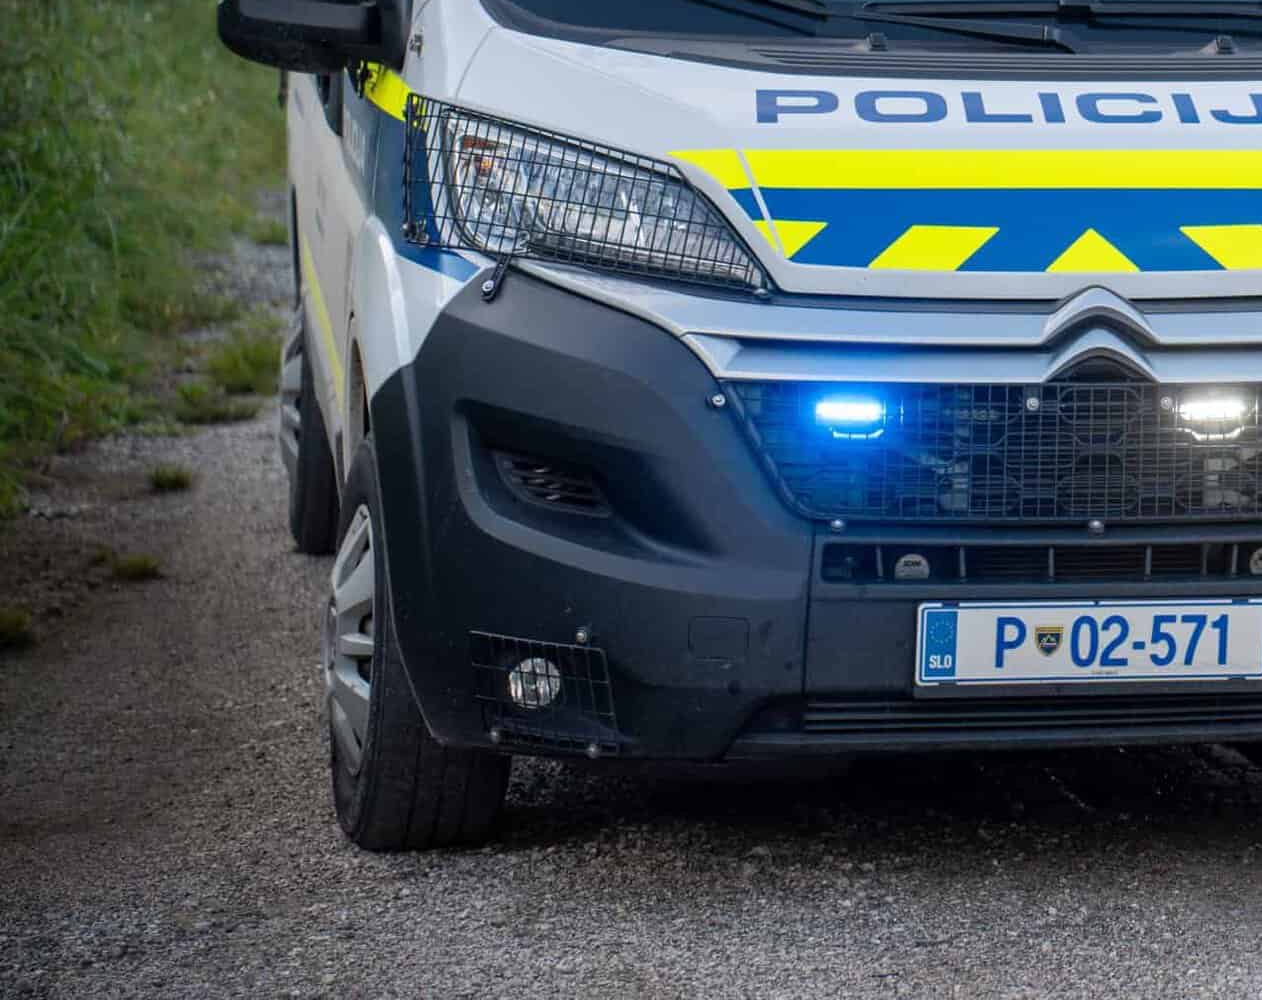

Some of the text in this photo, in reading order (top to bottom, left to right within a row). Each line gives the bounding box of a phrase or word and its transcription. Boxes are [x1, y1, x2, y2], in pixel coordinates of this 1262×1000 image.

[994, 613, 1229, 668] P 02-571
[929, 654, 952, 669] SLO
